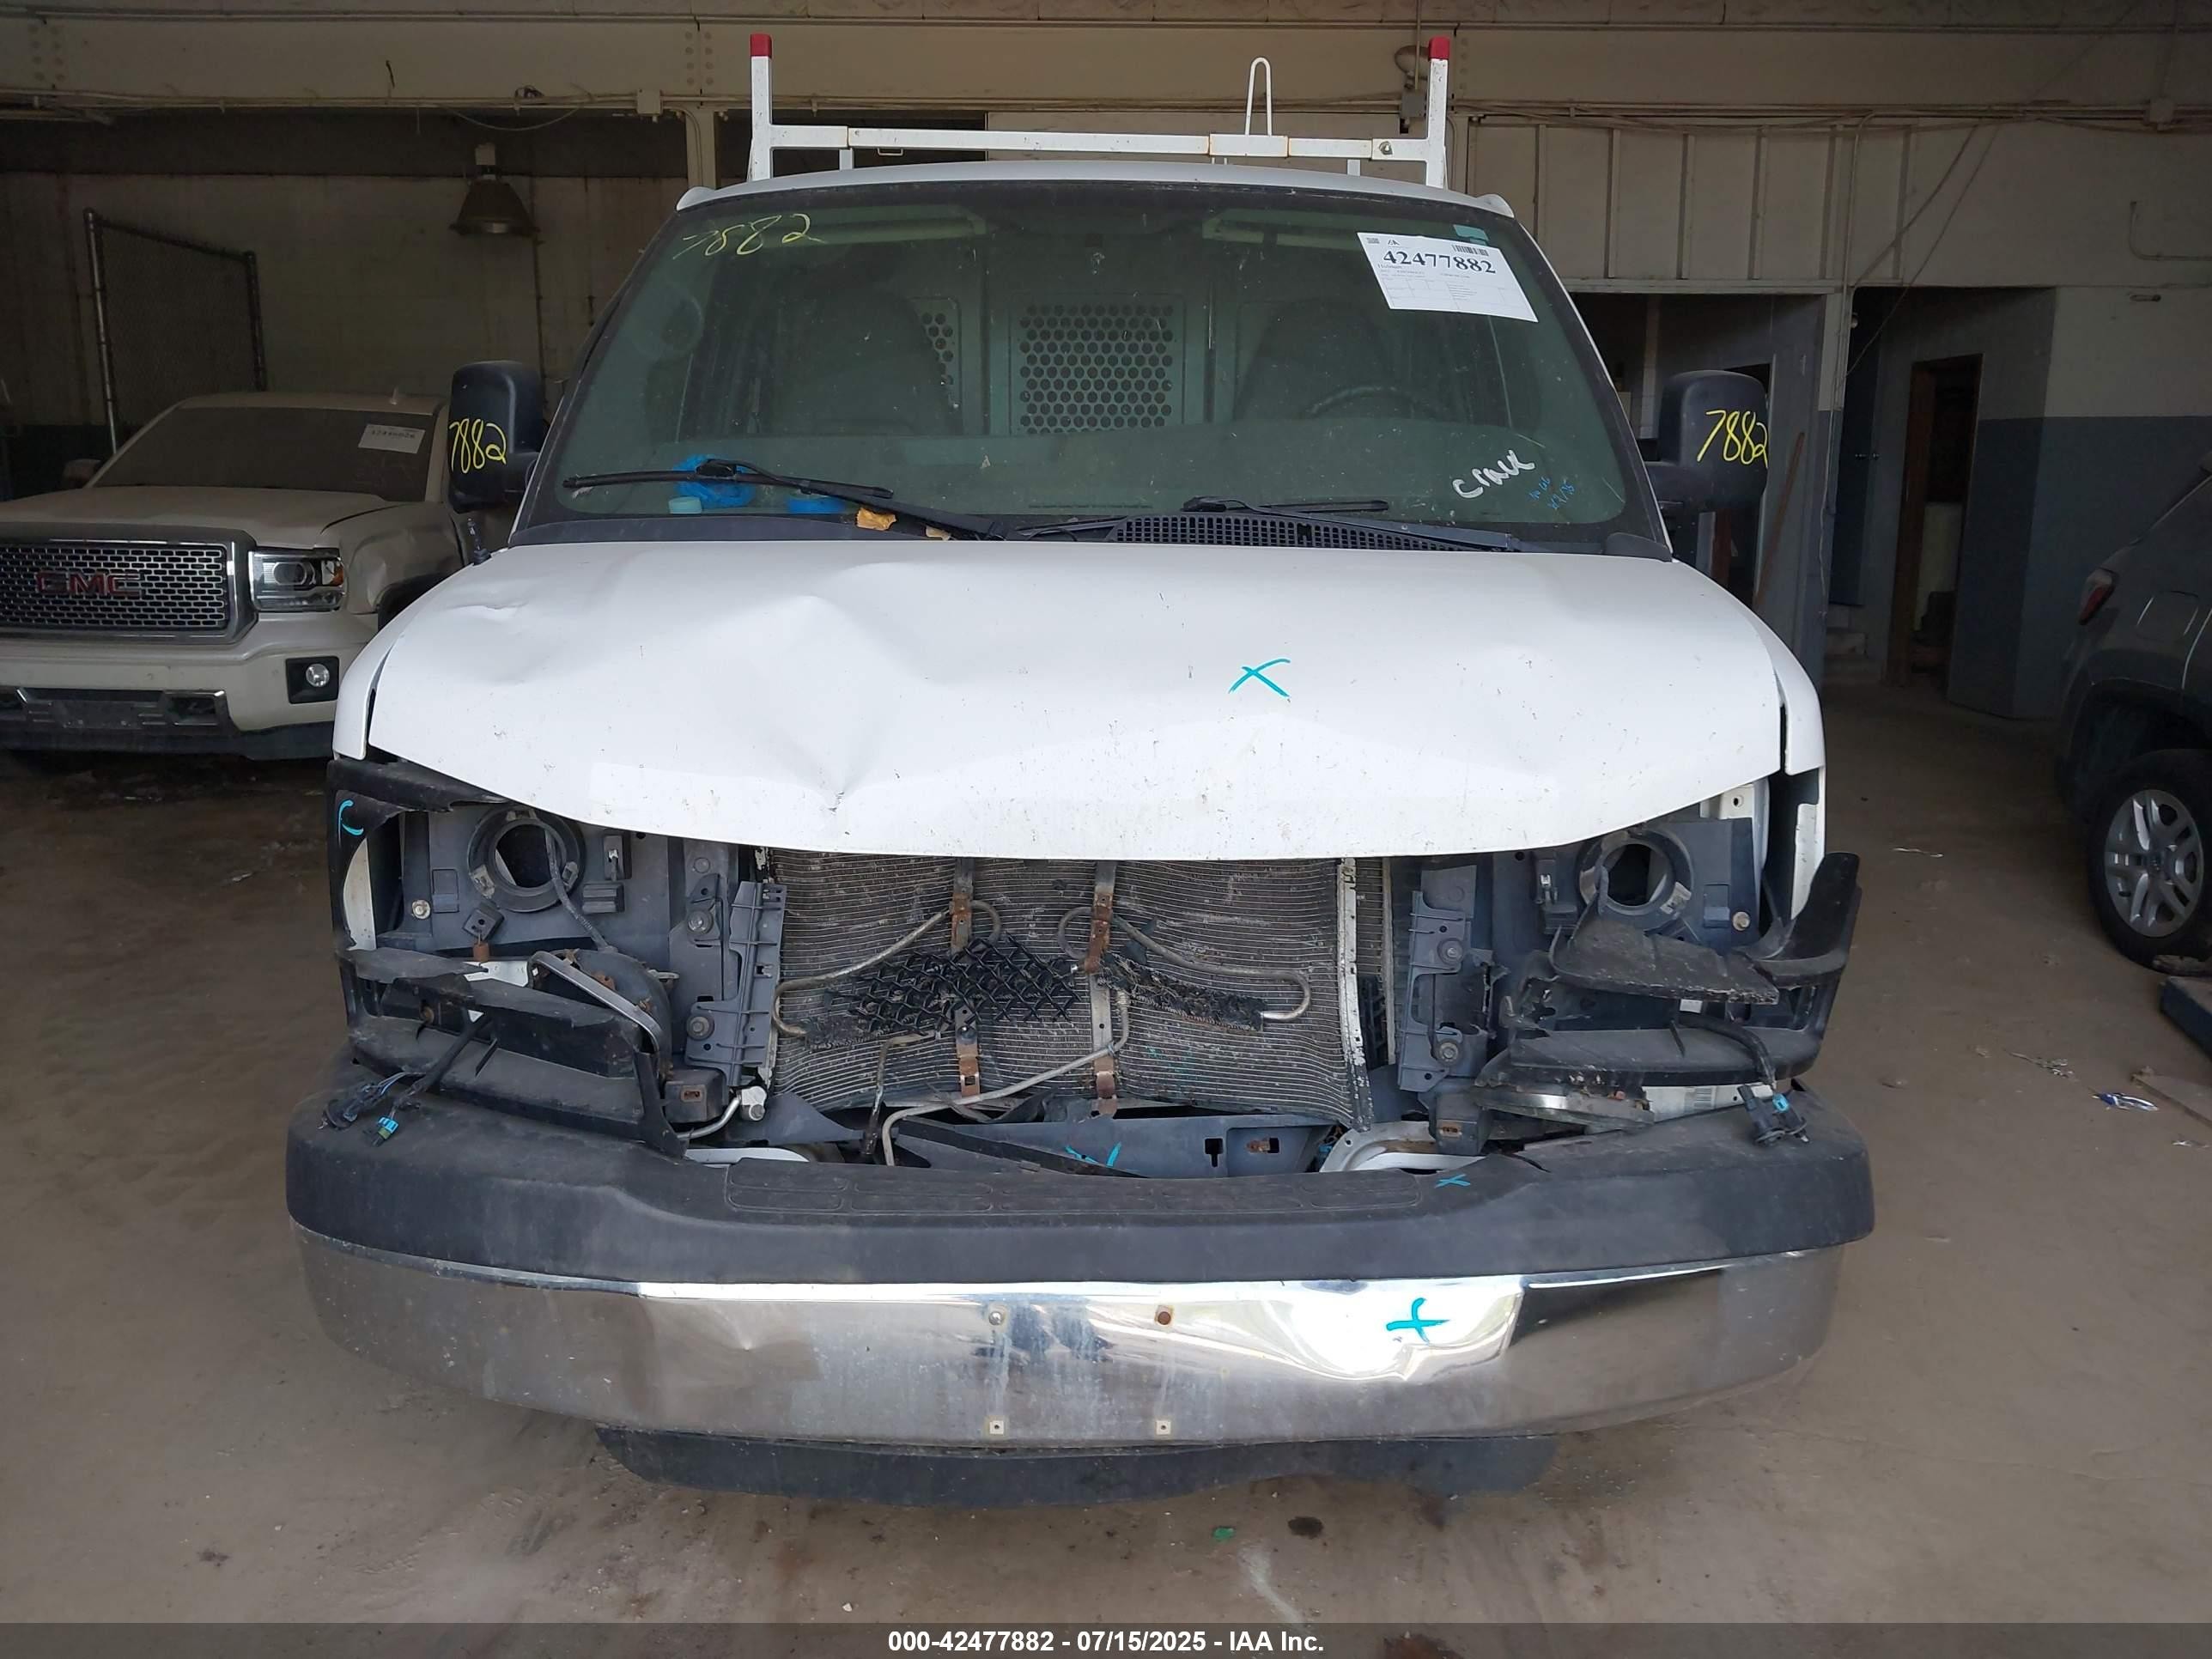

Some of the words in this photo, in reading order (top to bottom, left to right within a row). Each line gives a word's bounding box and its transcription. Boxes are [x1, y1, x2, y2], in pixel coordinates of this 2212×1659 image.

[673, 213, 830, 259] 7882
[1382, 250, 1496, 274] 42477882
[449, 418, 507, 474] 7882
[1697, 410, 1769, 469] 7882
[35, 570, 143, 599] GMC
